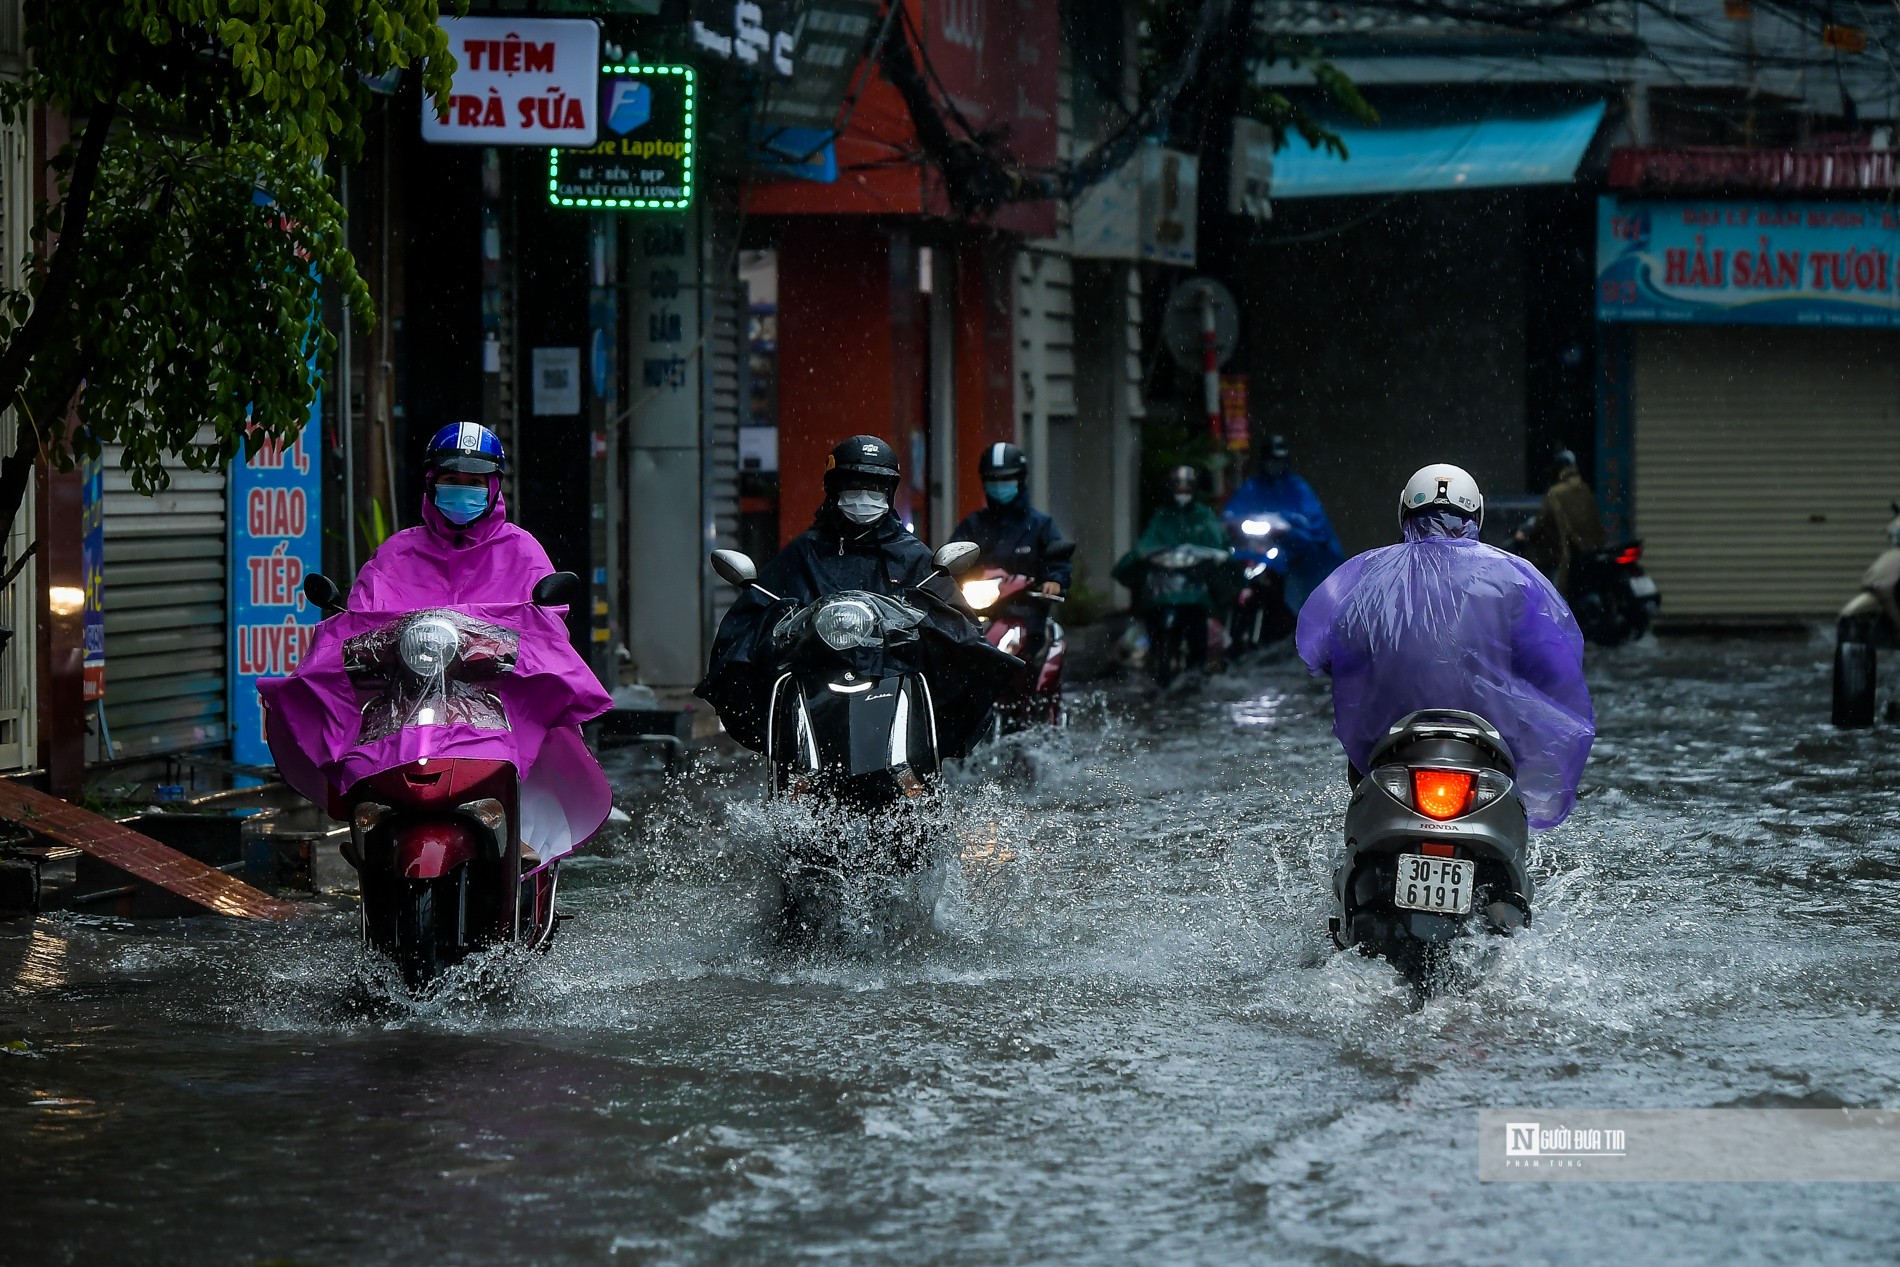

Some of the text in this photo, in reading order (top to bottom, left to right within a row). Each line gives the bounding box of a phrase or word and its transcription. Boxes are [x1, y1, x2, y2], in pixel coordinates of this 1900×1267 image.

[464, 33, 555, 77] TIỆM
[518, 86, 586, 129] SỮA
[621, 138, 685, 160] Laptop
[1665, 233, 1724, 287] HẢI
[1733, 235, 1801, 288] SẢN
[1810, 245, 1888, 291] TƯƠI
[248, 488, 307, 537] GIAO
[248, 541, 306, 610] TIẾP,
[1419, 823, 1460, 831] HONDA
[1409, 859, 1462, 885] 30-F6
[1406, 884, 1460, 908] 6191
